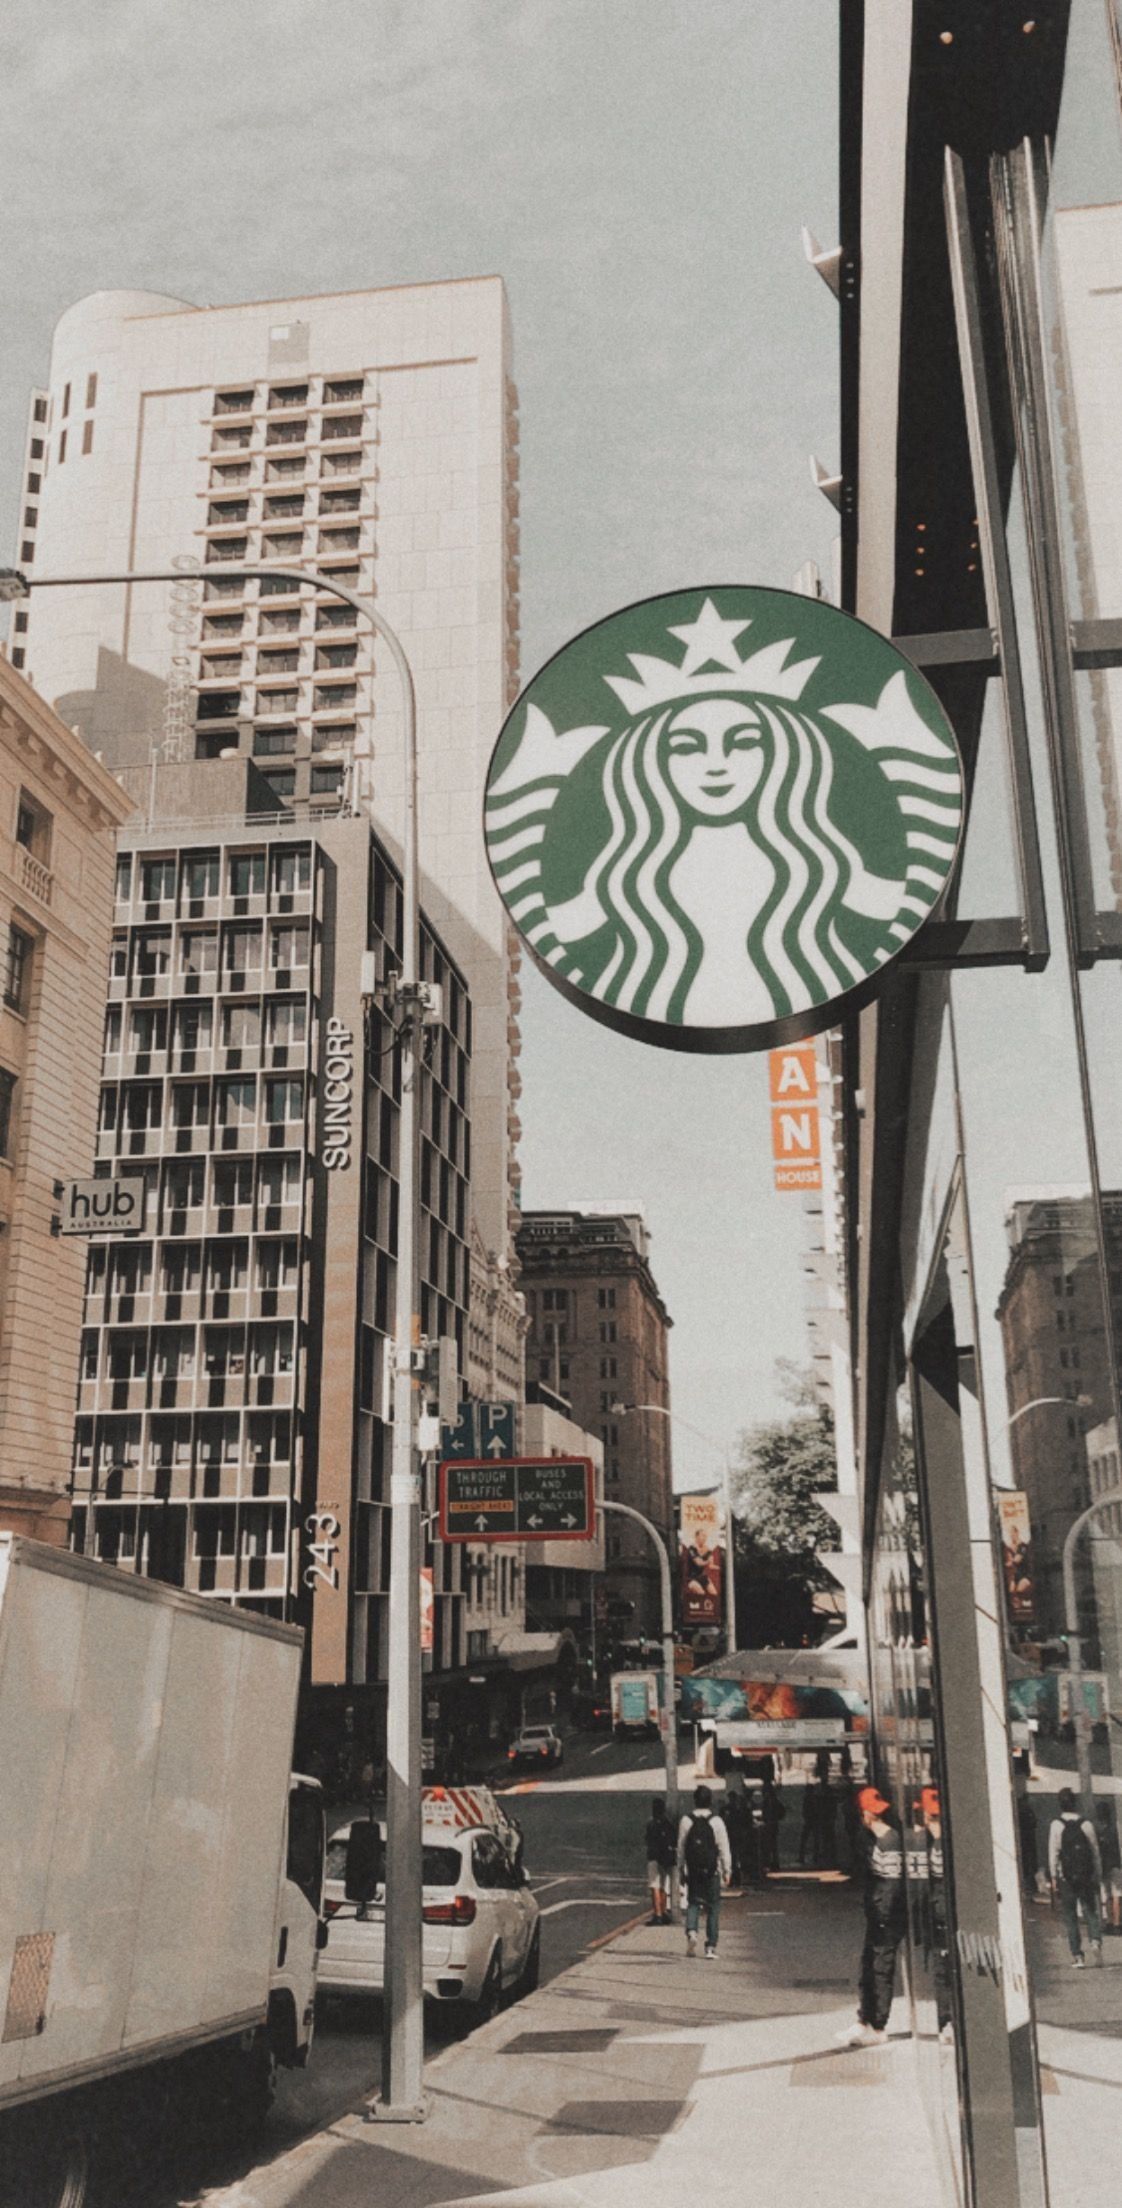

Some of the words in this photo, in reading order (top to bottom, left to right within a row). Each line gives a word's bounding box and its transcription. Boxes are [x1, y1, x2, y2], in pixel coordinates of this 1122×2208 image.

[322, 1016, 352, 1168] SUNCORP
[777, 1170, 819, 1184] HOUSE
[70, 1181, 135, 1218] hub
[70, 1220, 132, 1228] AUSTRALIA
[489, 1404, 507, 1430] P
[456, 1471, 507, 1484] THROUGH
[535, 1468, 567, 1479] BUSES
[541, 1478, 562, 1489] AND
[459, 1487, 503, 1498] TRAFFIC
[519, 1491, 545, 1501] LOCAL
[551, 1490, 584, 1500] ACCESS
[539, 1502, 564, 1512] ONLY
[687, 1504, 715, 1513] TWO
[685, 1512, 715, 1522] TIME
[303, 1513, 338, 1588] 243
